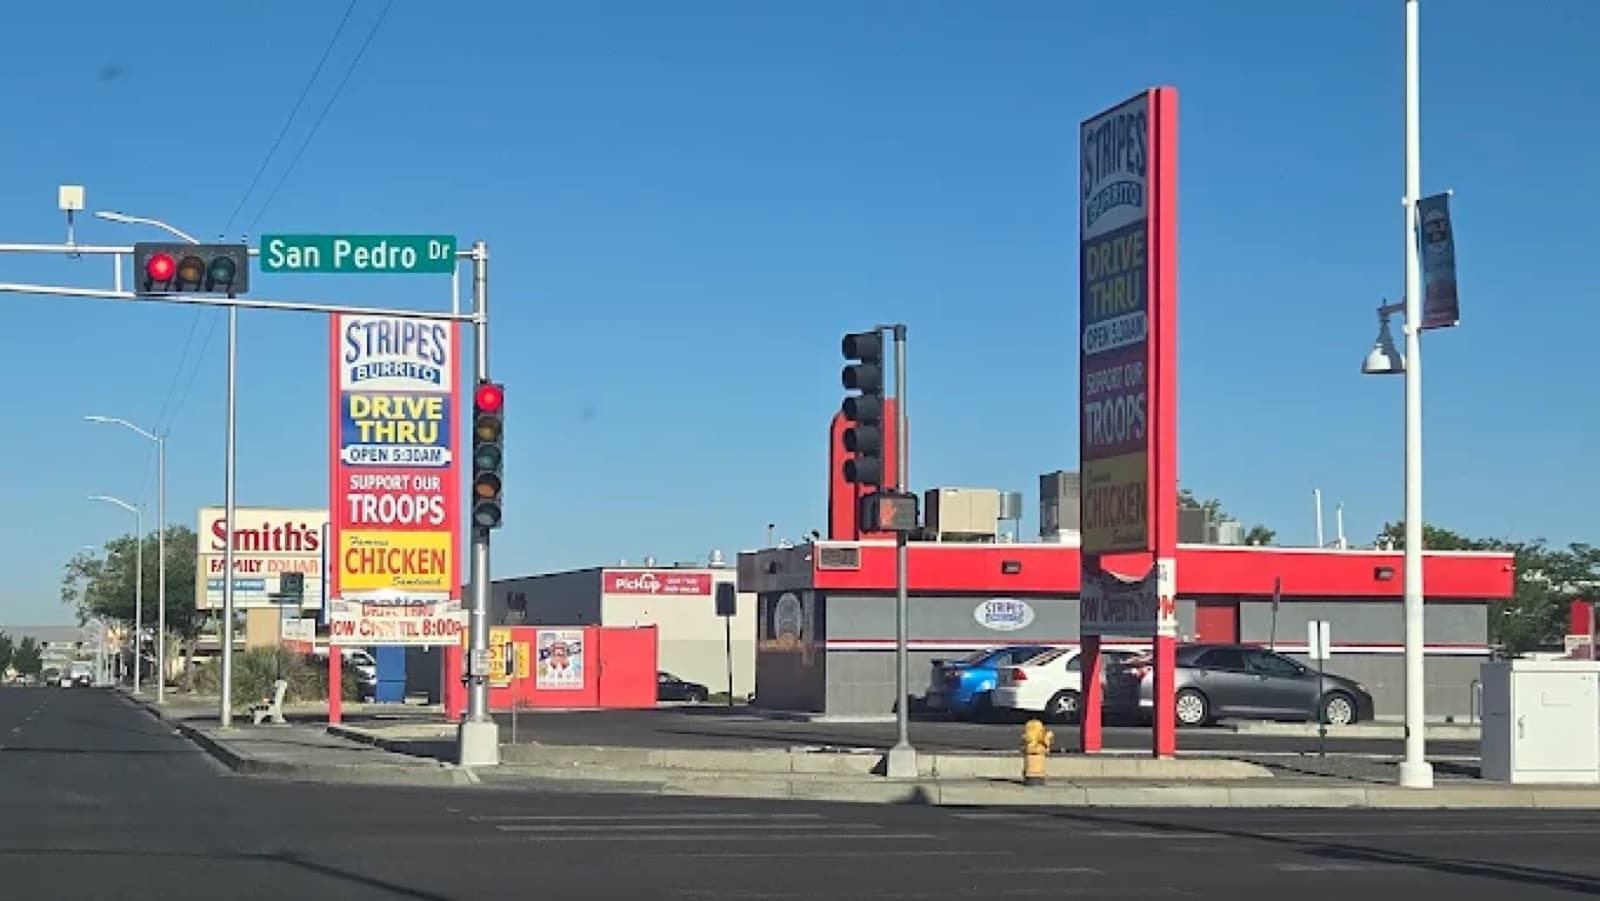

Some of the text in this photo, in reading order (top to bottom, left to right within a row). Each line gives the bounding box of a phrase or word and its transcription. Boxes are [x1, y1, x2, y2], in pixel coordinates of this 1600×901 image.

[1085, 109, 1146, 201] STRIPES
[1087, 181, 1142, 228] BURRITO
[268, 239, 450, 269] San Pedro Dr
[1086, 230, 1145, 281] DRIVE
[1090, 271, 1141, 318] THRU
[345, 319, 448, 366] STRIPES
[357, 361, 436, 384] BURRITO
[350, 395, 443, 420] DRIVE
[1085, 392, 1145, 447] TROOPS
[355, 420, 438, 444] THRU
[350, 448, 442, 463] OPEN 5:30AM
[350, 474, 441, 492] SUPPORT OUR
[347, 493, 445, 525] TROOPS
[211, 519, 320, 552] Smith's
[345, 547, 446, 575] CHICKEN
[331, 620, 355, 636] OW
